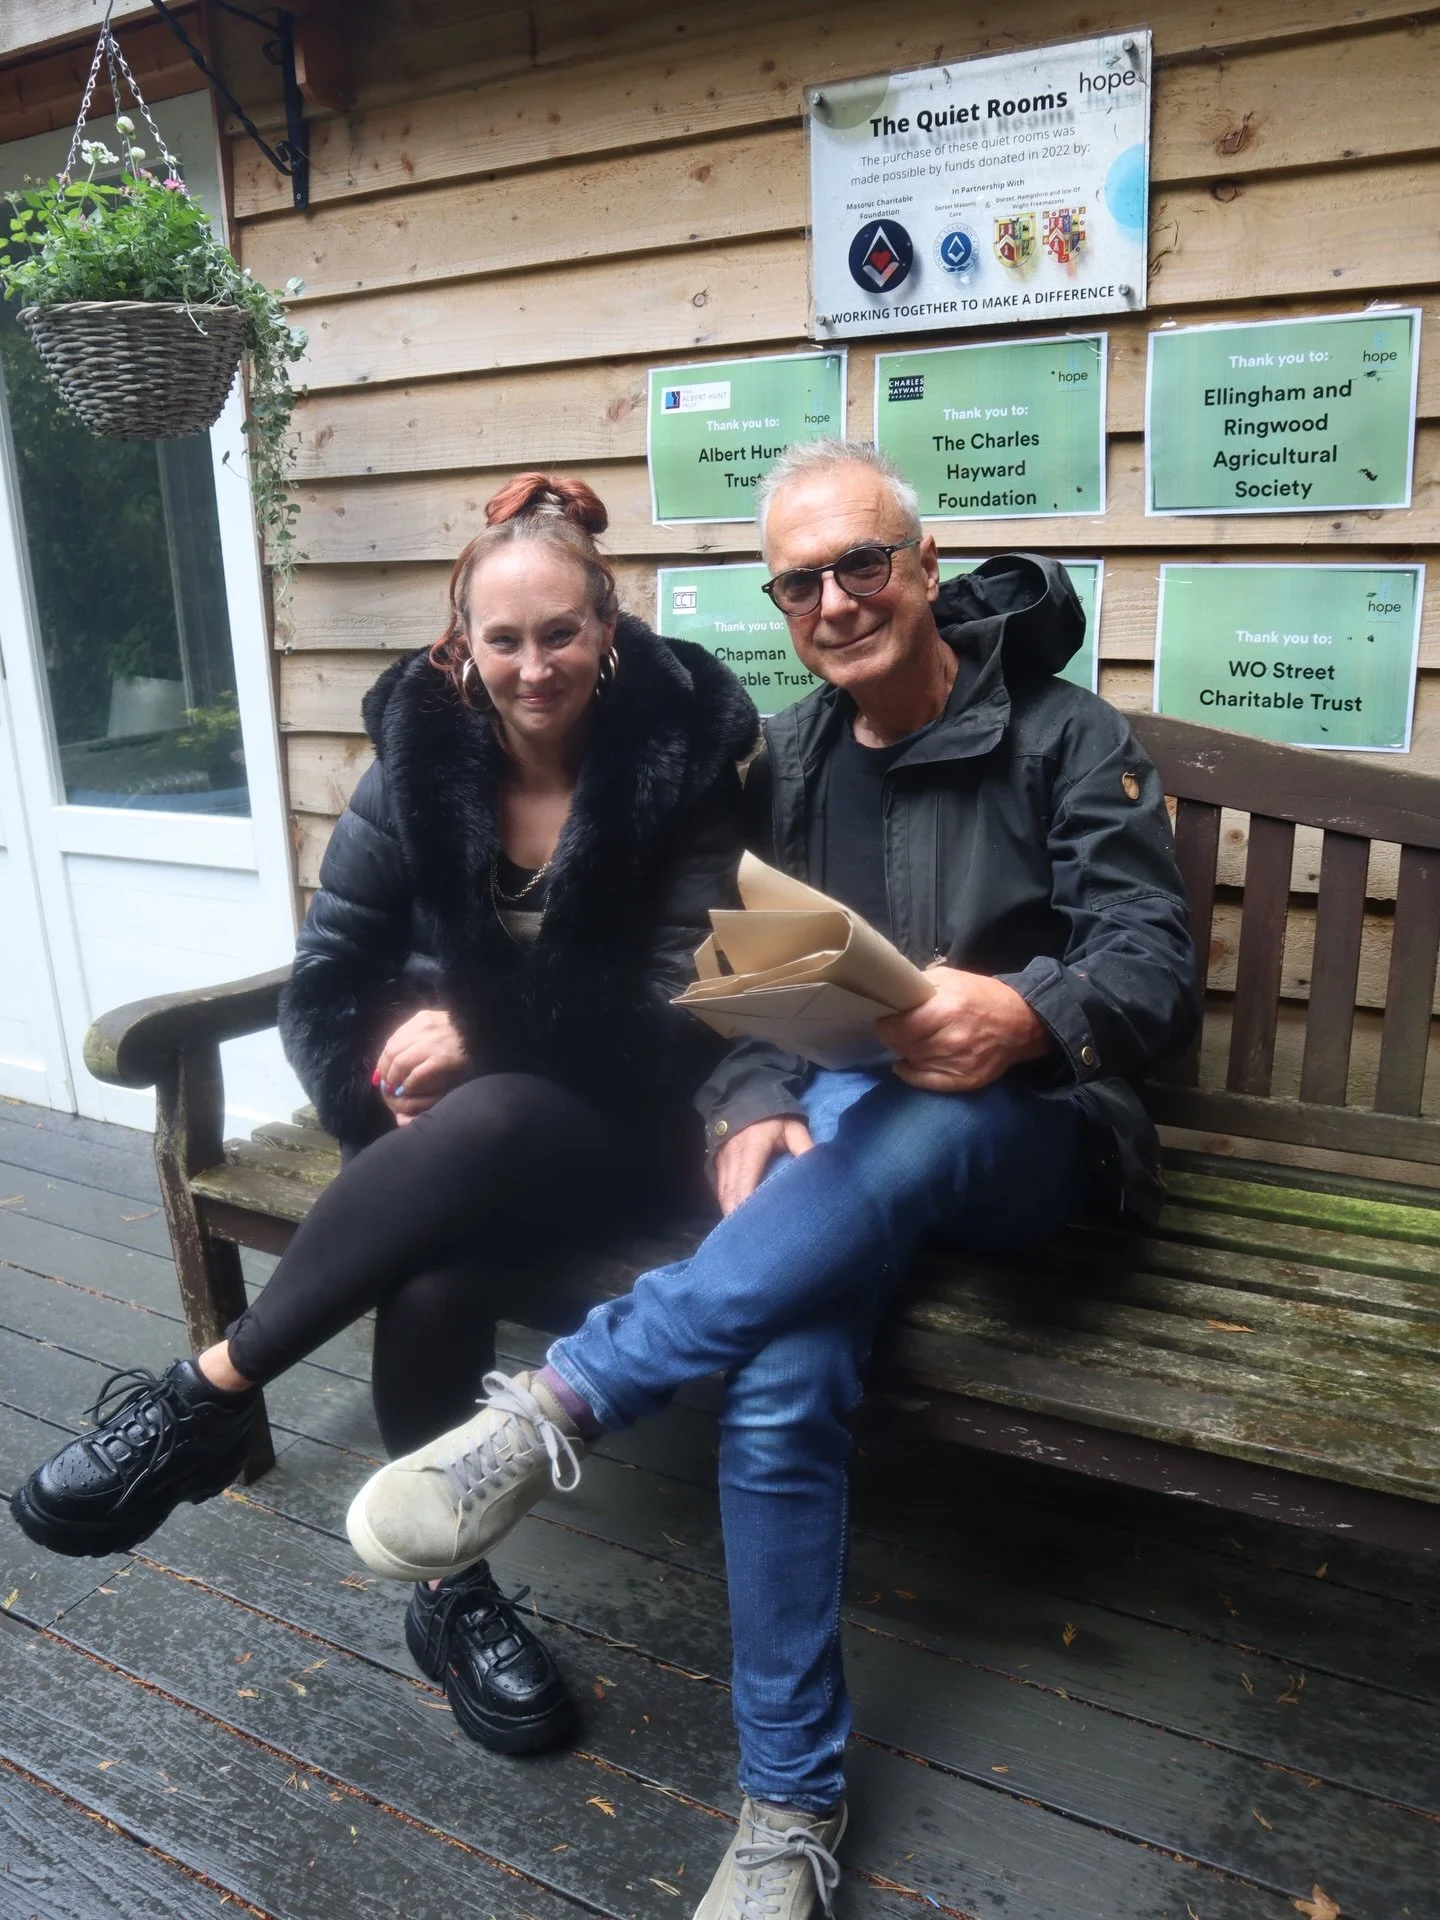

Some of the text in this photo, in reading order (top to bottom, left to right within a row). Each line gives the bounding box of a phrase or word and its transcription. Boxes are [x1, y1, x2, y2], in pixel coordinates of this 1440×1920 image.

[1079, 69, 1136, 94] hope
[870, 91, 1068, 137] The Quiet Rooms
[861, 126, 1076, 166] The purchase of these quiet rooms was
[850, 143, 1091, 186] made possible by funds donated in 2022 by:
[961, 182, 1005, 194] Partnership
[1006, 179, 1025, 188] With
[846, 195, 913, 211] Masonic Charitable
[860, 209, 900, 220] Foundation
[831, 285, 1115, 324] WORKING TOGETHER TO MAKE A DIFFERENCE
[1228, 351, 1329, 369] Thank you to:
[1363, 350, 1398, 365] hope
[889, 378, 924, 388] CHARLES
[1058, 370, 1088, 384] hope
[888, 386, 924, 395] HAYWARD
[1204, 379, 1352, 407] Ellingham and
[804, 412, 830, 425] hope
[943, 404, 1029, 421] Thank you to:
[706, 417, 780, 433] Thank you to:
[1224, 413, 1329, 438] Ringwood
[932, 431, 1040, 452] The Charles
[698, 446, 747, 463] Albert
[1212, 445, 1338, 471] Agricultural
[947, 460, 1026, 482] Hayward
[1235, 479, 1313, 500] Society
[938, 490, 1037, 509] Foundation
[674, 594, 695, 607] CCT
[1367, 600, 1402, 614] hope
[713, 621, 784, 634] Thank you to:
[1236, 630, 1332, 648] Thank you to:
[714, 647, 786, 664] Chapman
[740, 671, 814, 686] able Trust
[1229, 660, 1335, 681] WO Street
[1199, 689, 1363, 712] Charitable Trust
